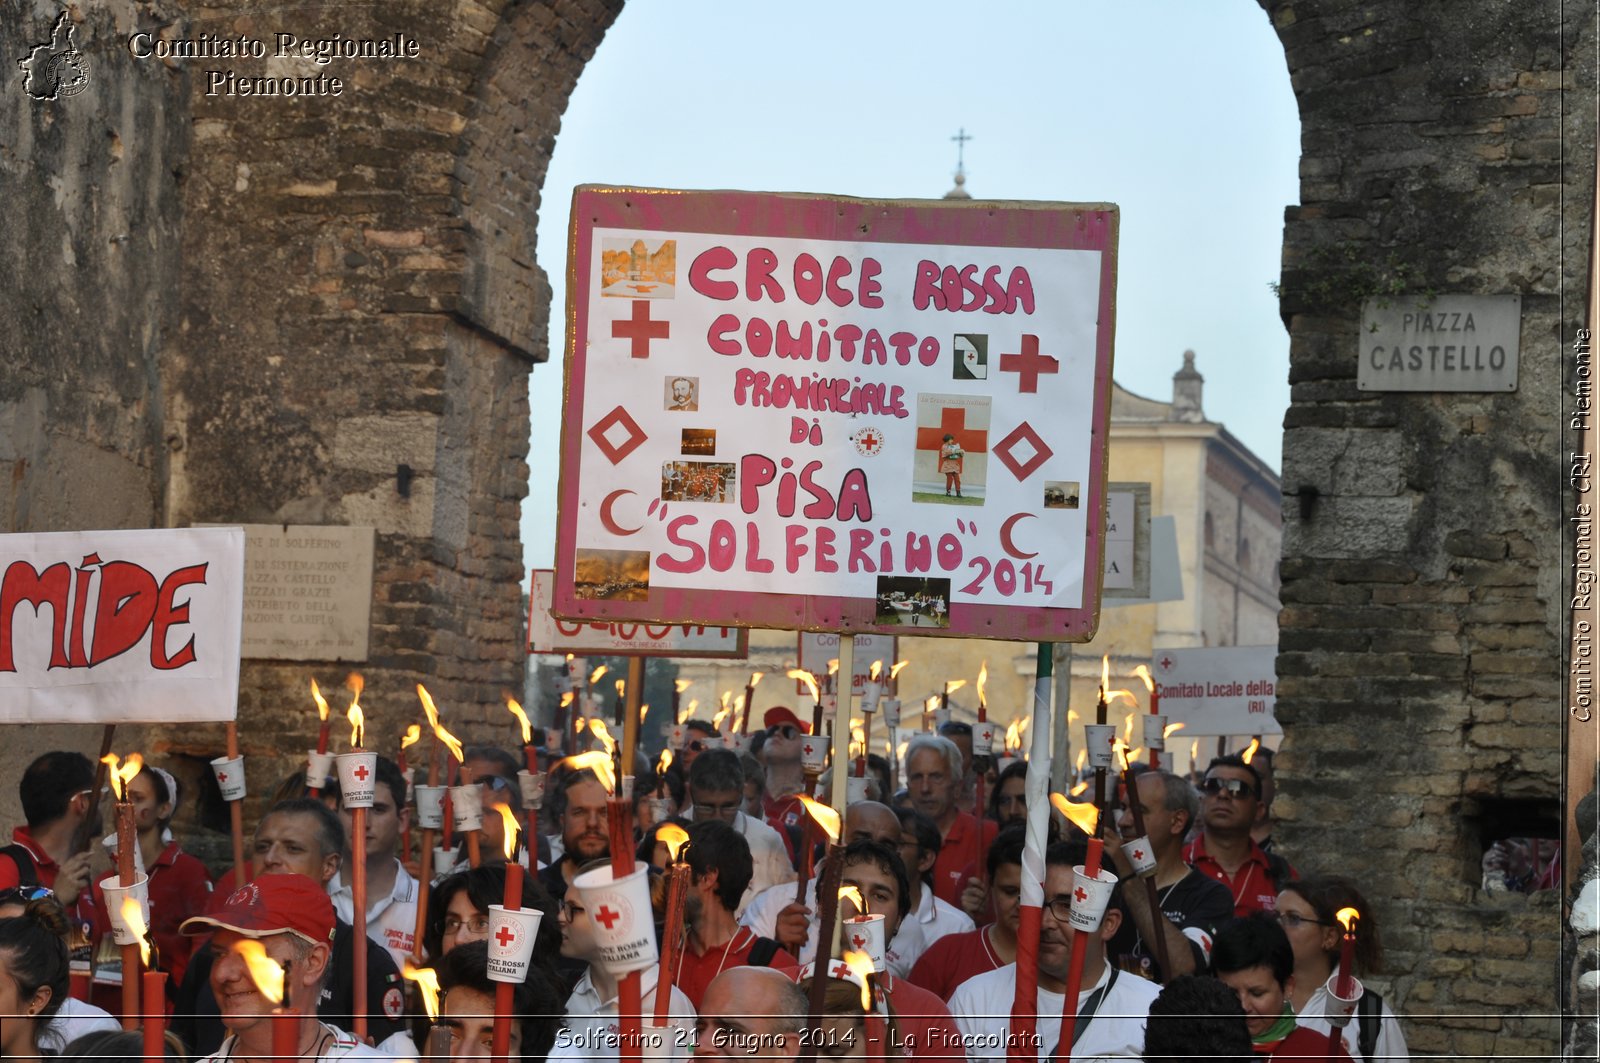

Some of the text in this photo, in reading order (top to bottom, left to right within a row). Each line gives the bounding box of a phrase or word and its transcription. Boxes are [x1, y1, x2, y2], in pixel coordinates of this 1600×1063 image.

[689, 246, 1035, 315] CROCE ROSSA
[1403, 311, 1476, 332] PIAZZA
[1370, 345, 1506, 371] CASTELLO
[270, 538, 280, 548] DI
[286, 538, 341, 549] SOLFERINO
[254, 560, 265, 570] DI
[270, 561, 349, 571] SISTEMAZIONE
[284, 575, 336, 585] CASTELLO
[958, 555, 1053, 597] 2014
[291, 588, 332, 598] GRAZIE
[306, 603, 338, 612] DELLA
[1155, 680, 1274, 699] Comitato Locale della
[1248, 699, 1266, 714] (RI)
[502, 960, 525, 969] ROSSA
